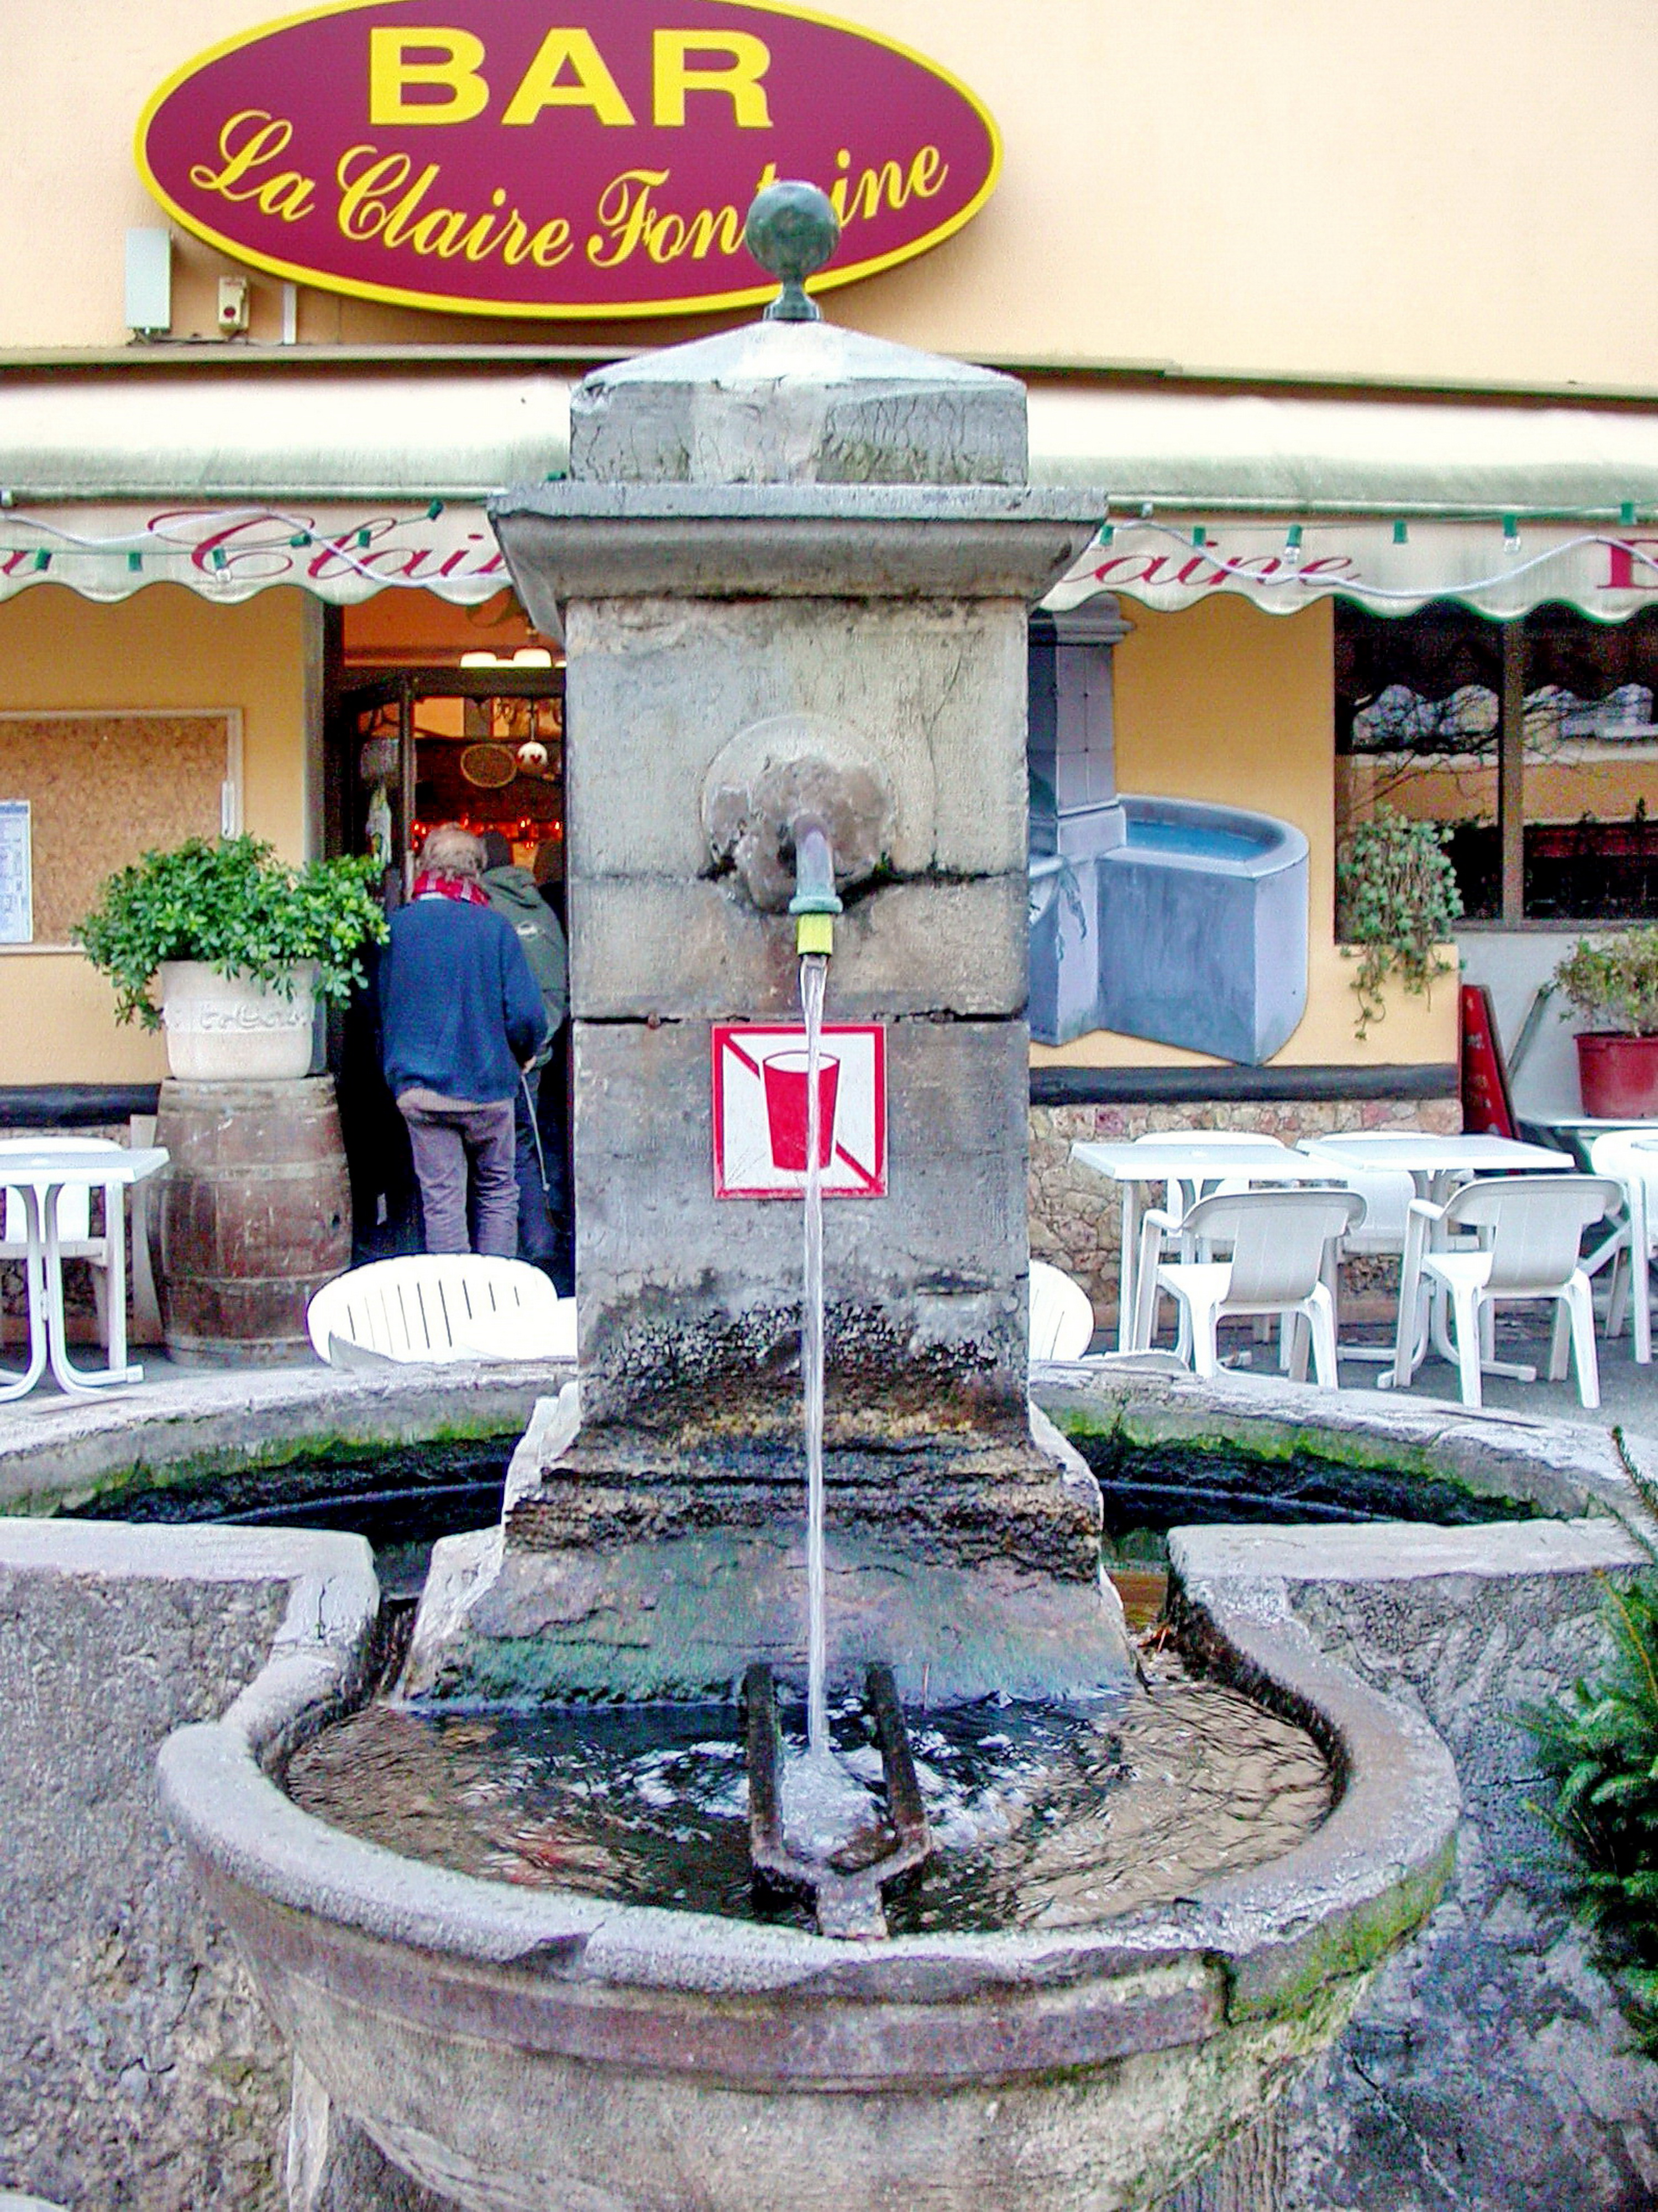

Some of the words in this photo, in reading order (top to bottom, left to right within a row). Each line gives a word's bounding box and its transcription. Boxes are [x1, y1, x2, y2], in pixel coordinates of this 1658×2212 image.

[369, 26, 775, 129] BAR
[190, 110, 315, 222] La
[337, 145, 574, 267] Claire
[586, 145, 949, 267] Fonine
